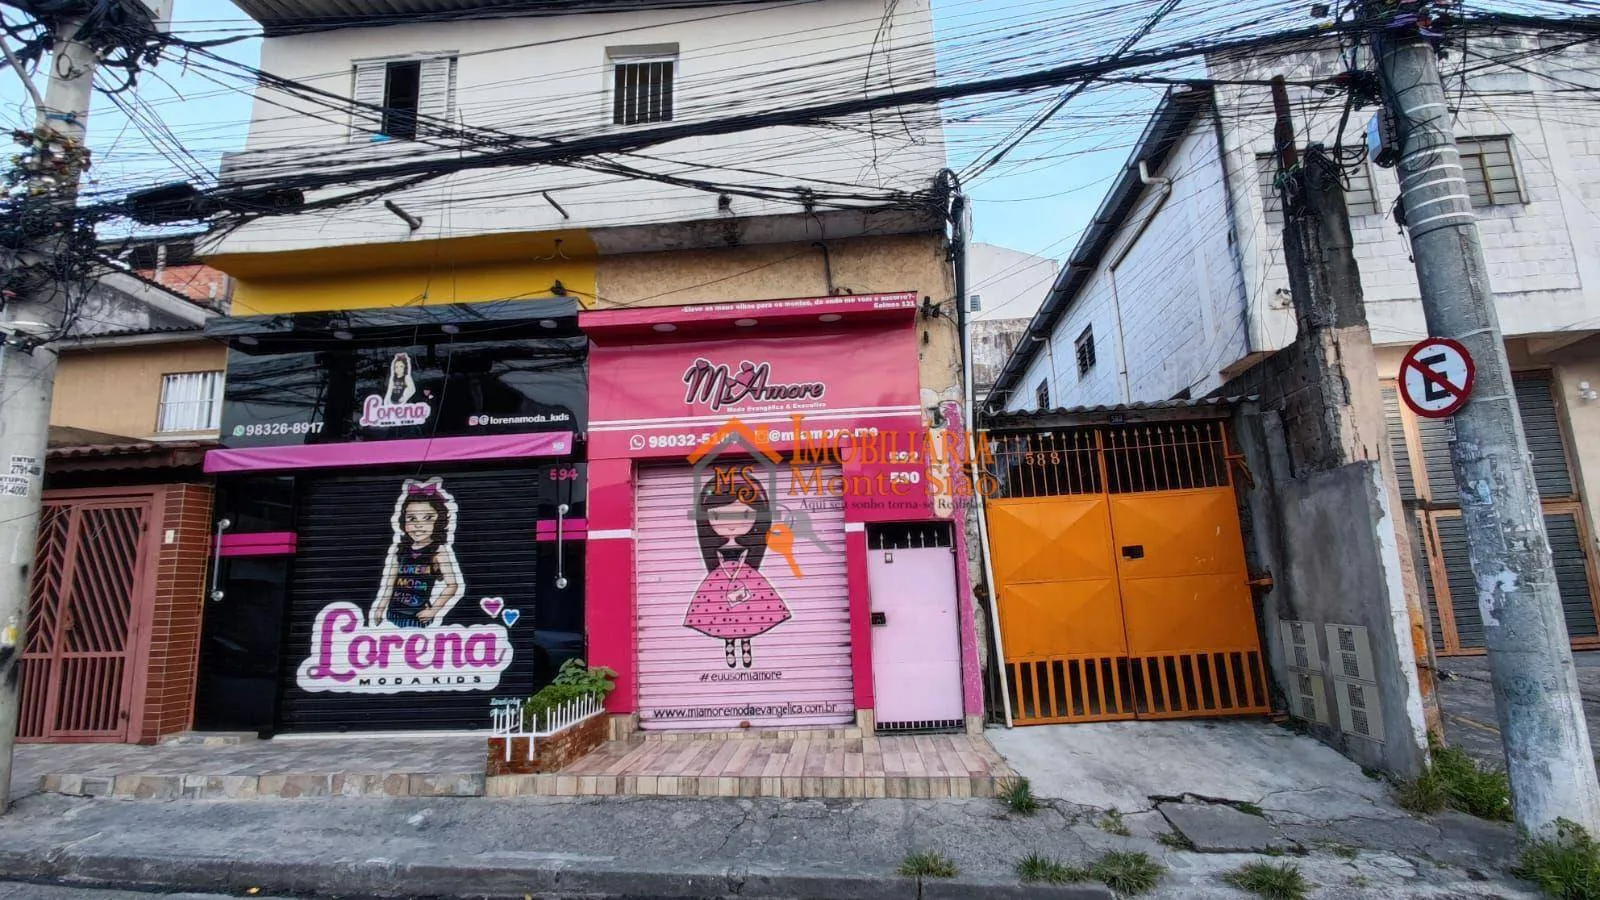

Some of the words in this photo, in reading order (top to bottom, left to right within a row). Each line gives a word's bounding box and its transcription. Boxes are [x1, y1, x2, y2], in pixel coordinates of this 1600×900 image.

[1420, 353, 1452, 402] E
[362, 396, 425, 425] Lorena
[246, 421, 325, 437] 98326-8917
[1025, 451, 1060, 466] 588
[549, 467, 578, 481] 594
[306, 608, 507, 682] Lorena
[359, 677, 421, 687] MODA
[432, 676, 482, 685] KIDS
[653, 700, 838, 719] www.miamoremodaevangelica.com.br
